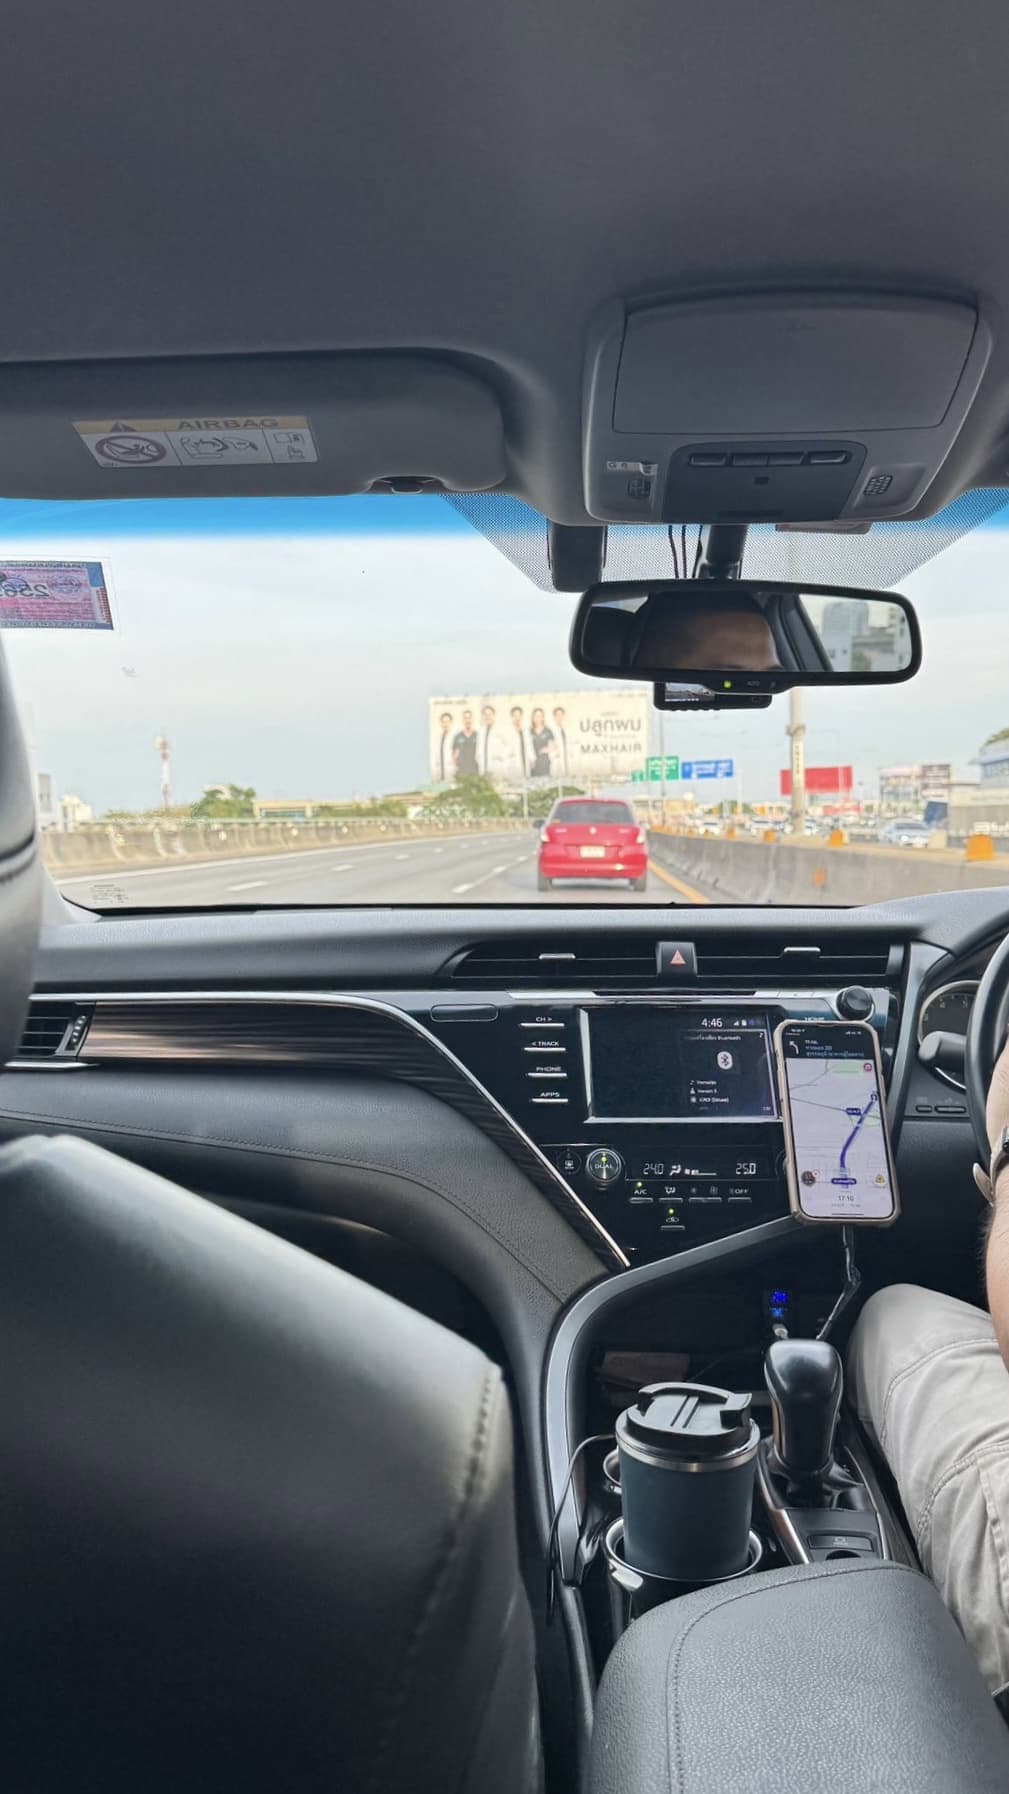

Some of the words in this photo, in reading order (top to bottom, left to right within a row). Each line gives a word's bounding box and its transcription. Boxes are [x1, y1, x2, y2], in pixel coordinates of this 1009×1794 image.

[178, 418, 279, 430] AIRBAG
[580, 743, 642, 753] MAXHAIR
[701, 1018, 723, 1027] 4:46
